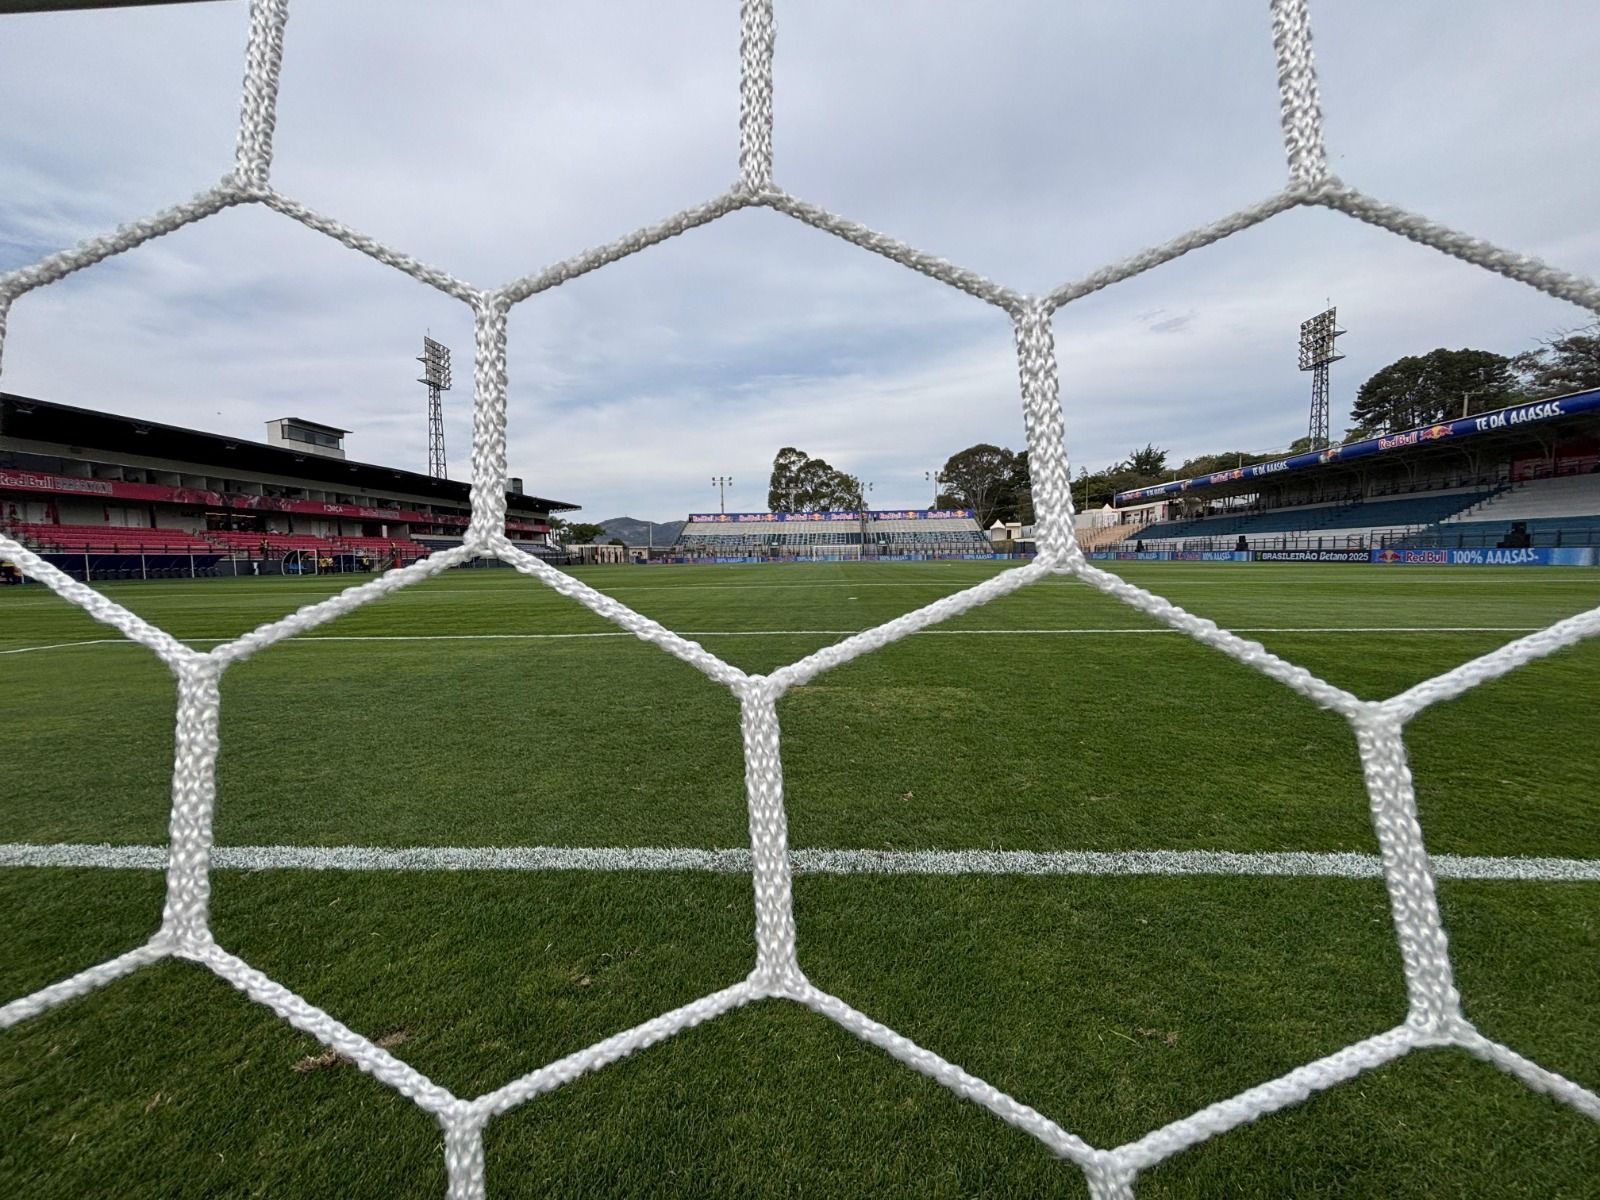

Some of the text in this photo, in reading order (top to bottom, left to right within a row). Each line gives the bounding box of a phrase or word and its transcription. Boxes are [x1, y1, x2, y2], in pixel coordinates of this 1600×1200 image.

[1475, 417, 1488, 431] TE
[1510, 401, 1565, 424] AAASAS.
[1262, 551, 1369, 561] BRASILEIRÃO Betano 2025
[1405, 547, 1539, 564] Red Bull 100% AAASAS.
